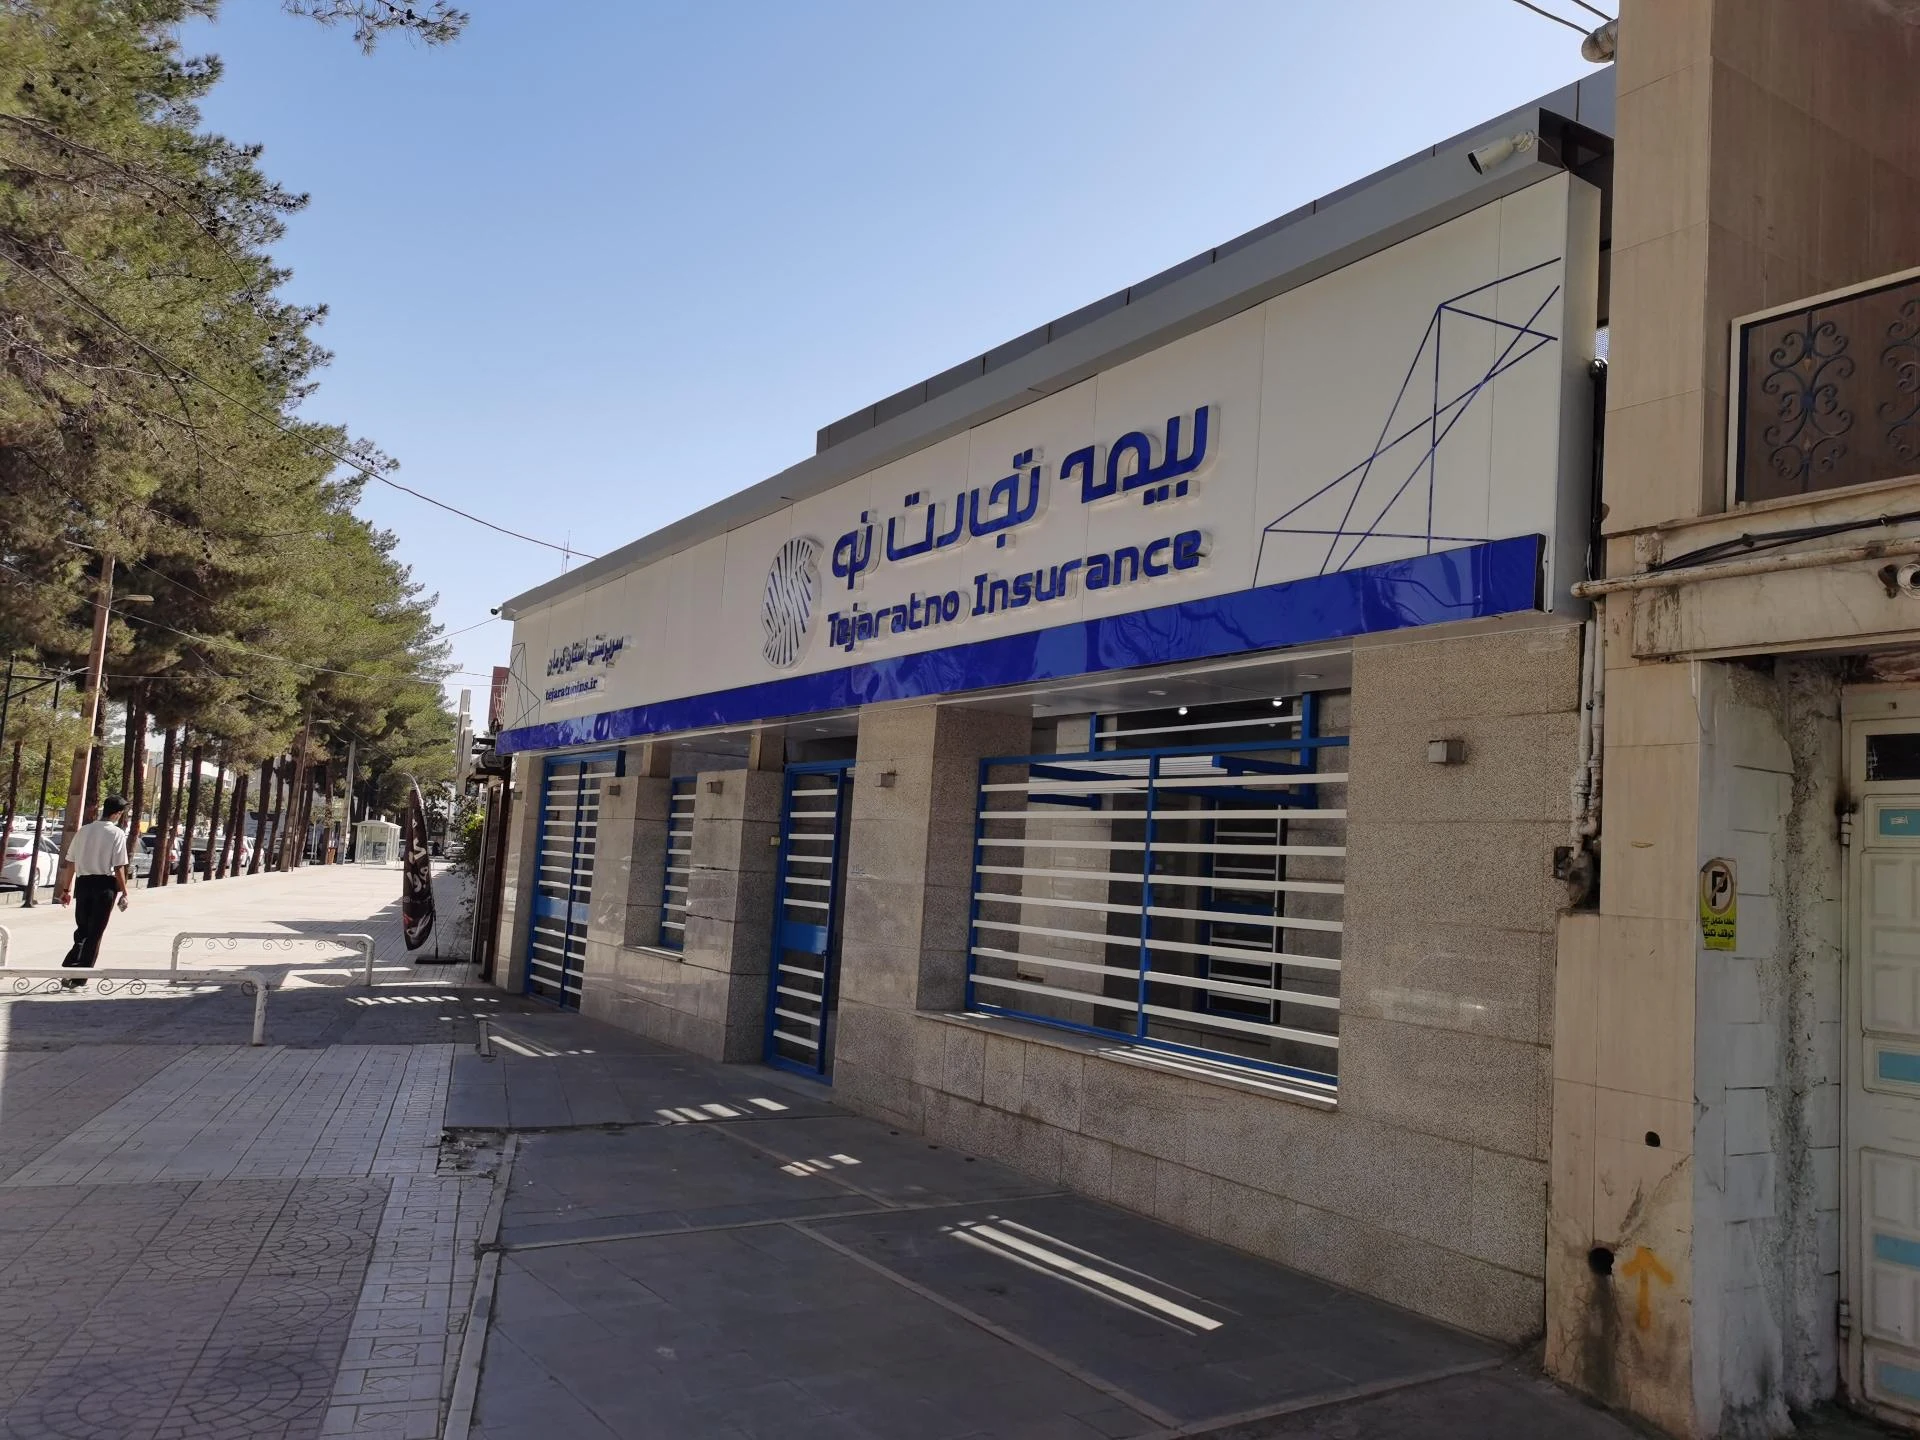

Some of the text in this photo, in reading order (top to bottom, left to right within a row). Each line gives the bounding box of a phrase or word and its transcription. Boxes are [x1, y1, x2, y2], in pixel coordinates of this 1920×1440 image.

[831, 405, 1209, 590] بیمه تجارت نو
[827, 529, 1203, 652] Tejaratno Insurance
